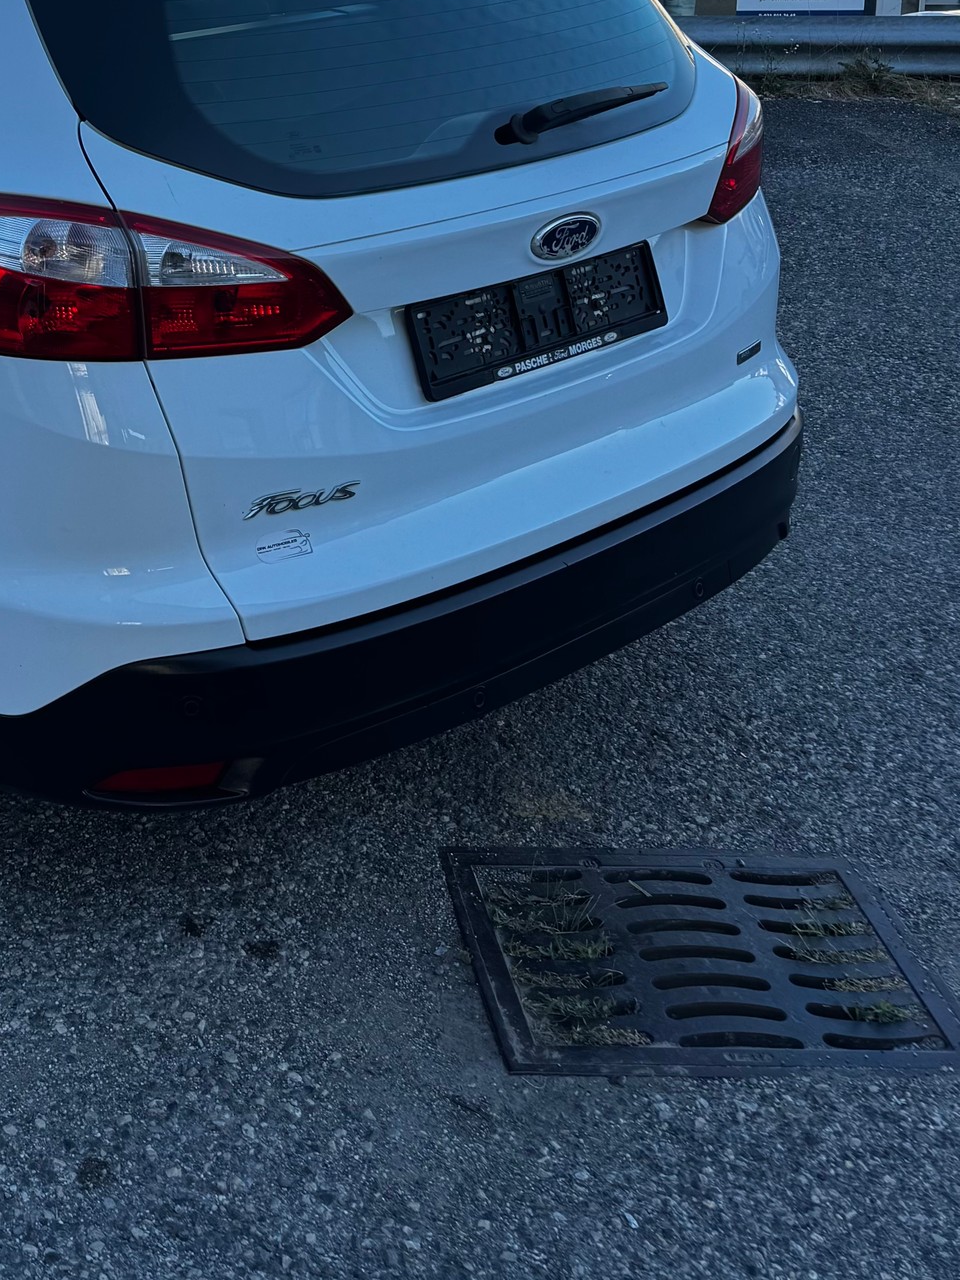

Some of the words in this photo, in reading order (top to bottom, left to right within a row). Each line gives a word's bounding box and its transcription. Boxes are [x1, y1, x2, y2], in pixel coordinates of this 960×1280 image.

[551, 222, 589, 251] Ford
[515, 354, 549, 373] PASCHE
[569, 336, 603, 356] MORGES
